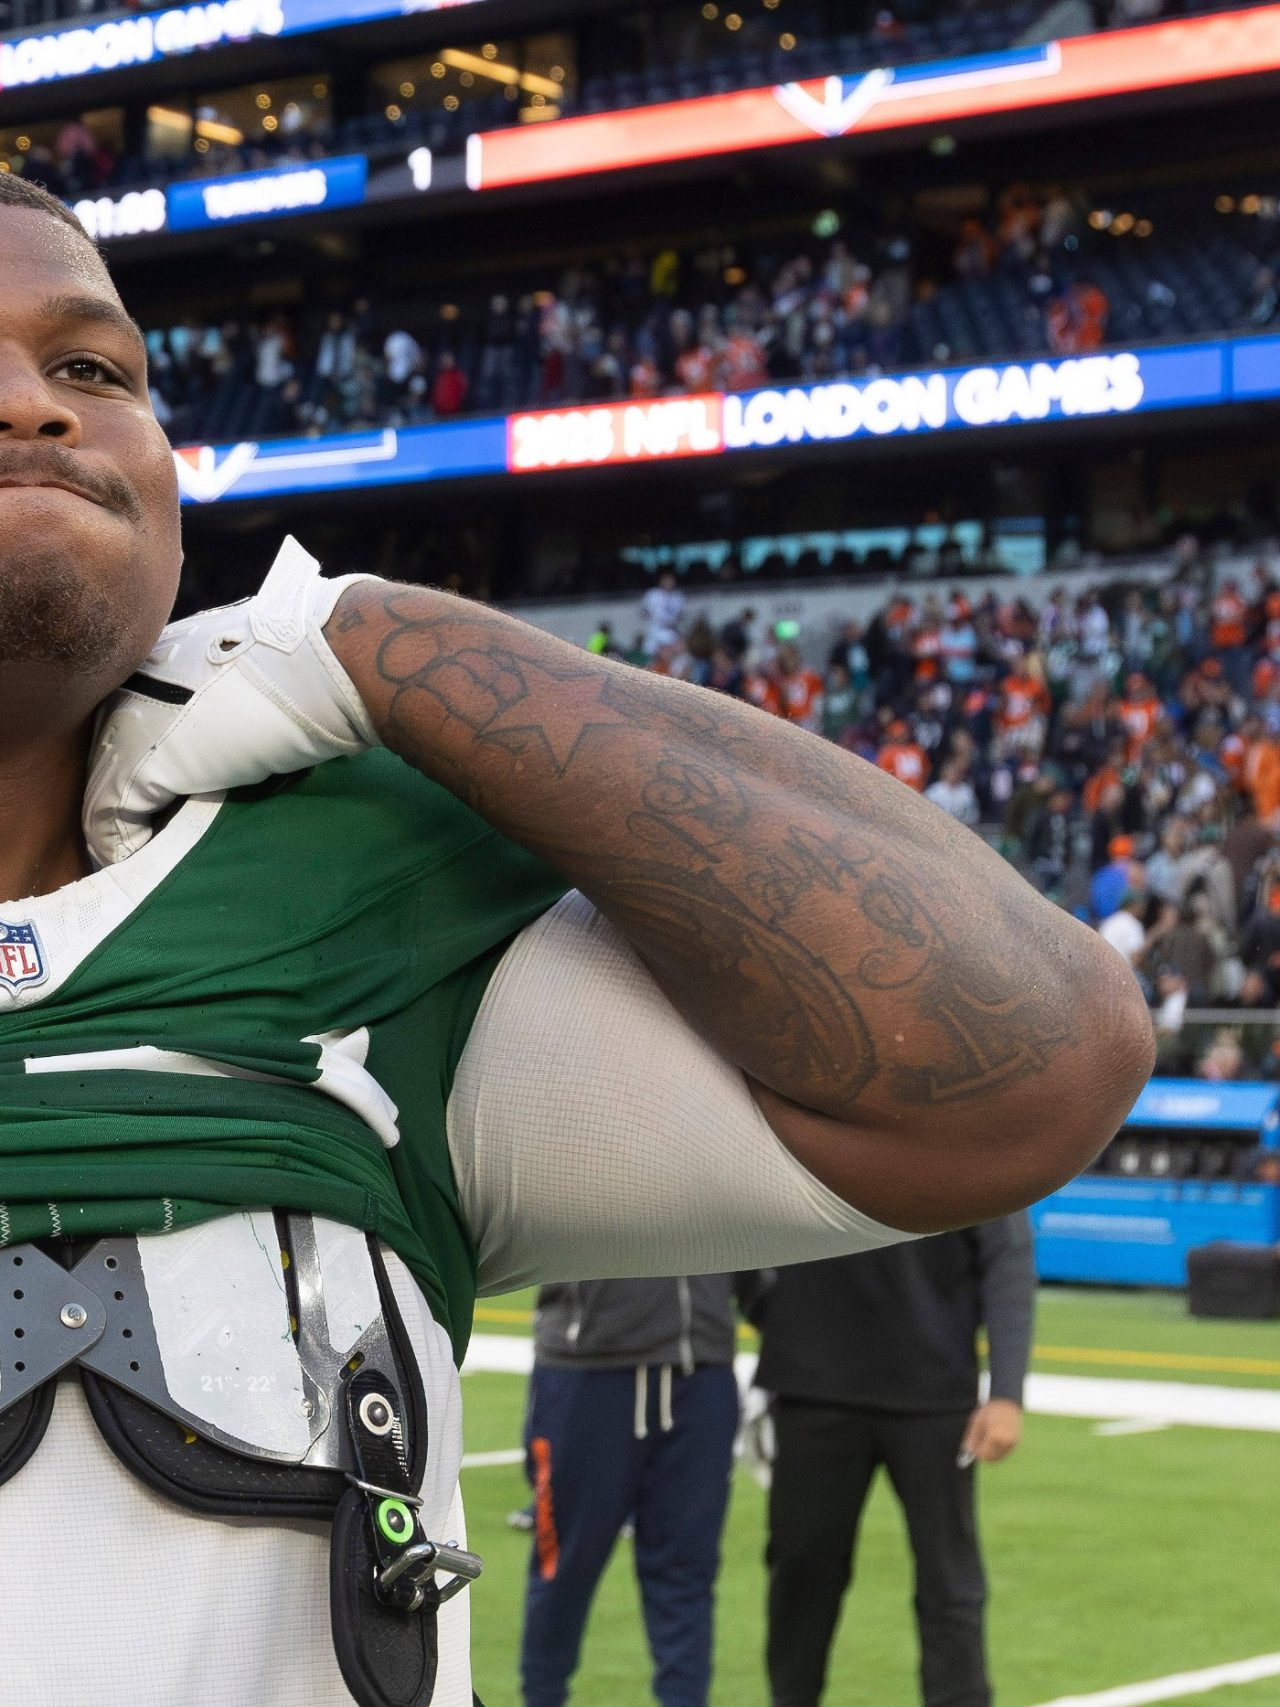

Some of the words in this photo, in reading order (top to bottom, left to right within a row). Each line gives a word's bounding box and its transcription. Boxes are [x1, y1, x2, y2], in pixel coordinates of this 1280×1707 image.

[0, 17, 154, 87] LONDON
[623, 399, 721, 458] NFL
[724, 373, 948, 449] LONDON
[953, 352, 1145, 426] GAMES
